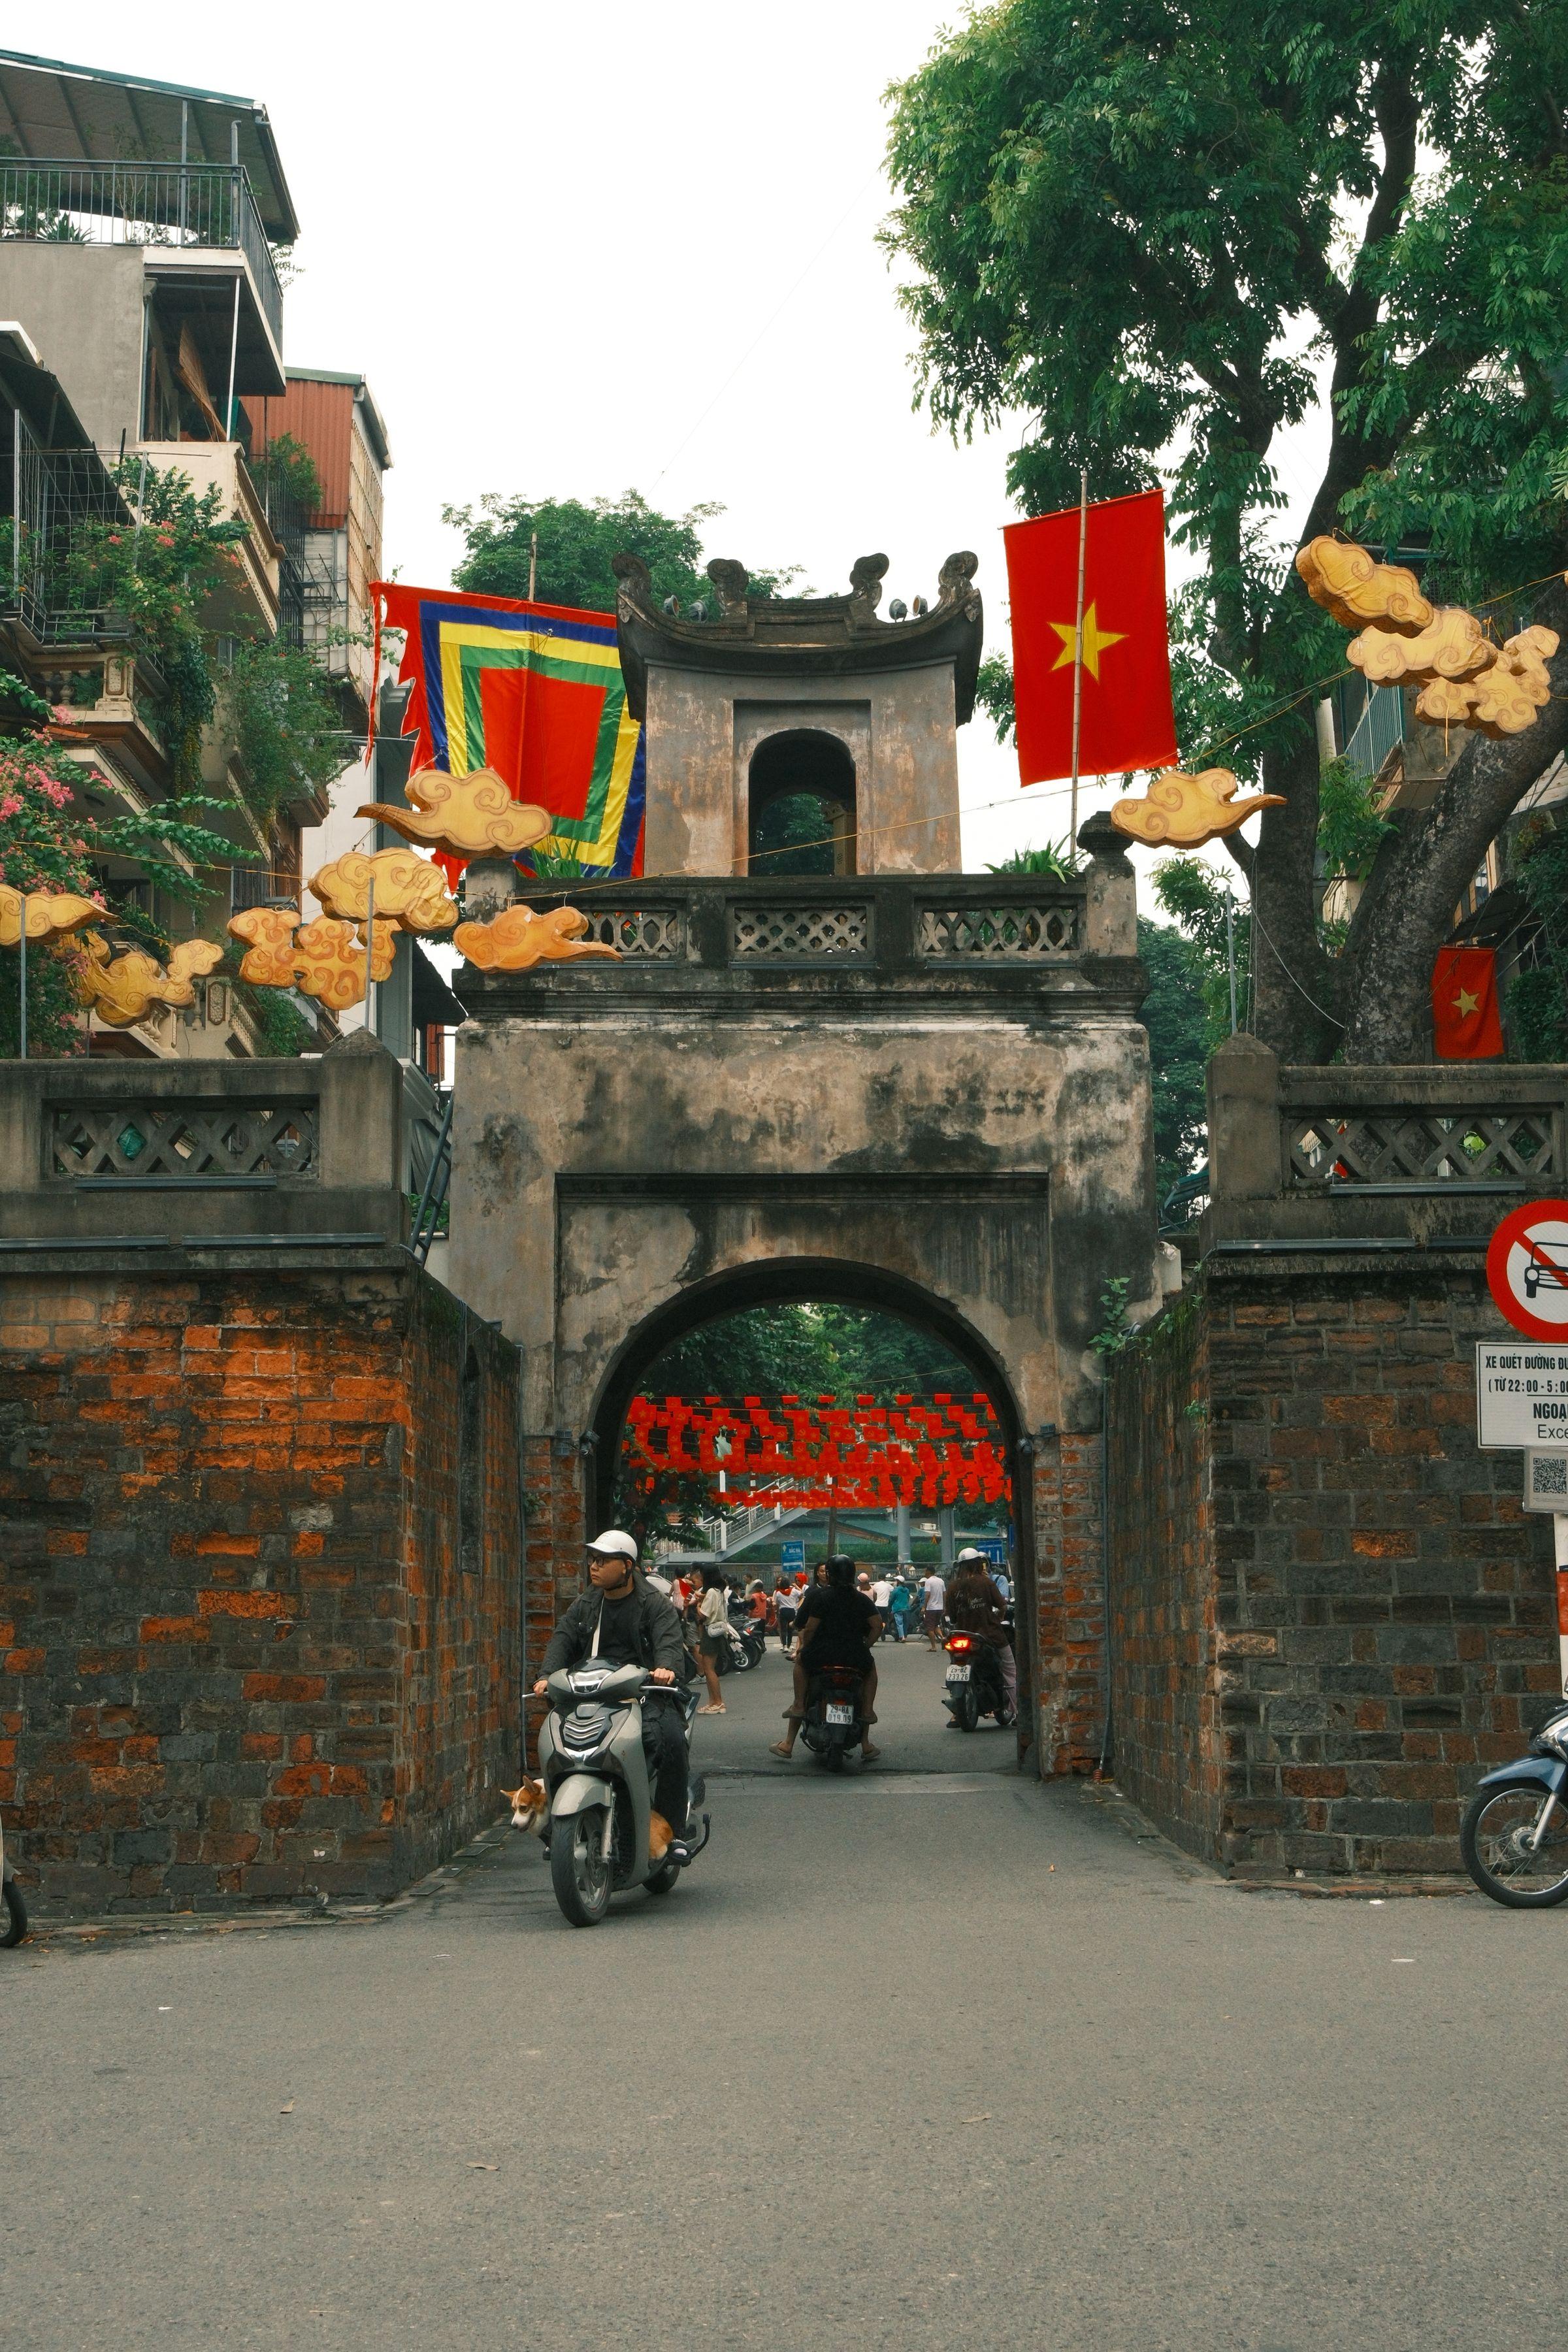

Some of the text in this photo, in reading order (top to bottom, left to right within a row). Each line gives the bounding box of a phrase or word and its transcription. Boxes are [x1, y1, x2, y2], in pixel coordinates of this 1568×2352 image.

[1486, 1356, 1497, 1369] XE
[1499, 1353, 1522, 1369] QUÉT
[1525, 1353, 1556, 1370] ĐƯỜNG
[1533, 1403, 1568, 1422] NGOẠ
[828, 1714, 851, 1723] 019.09
